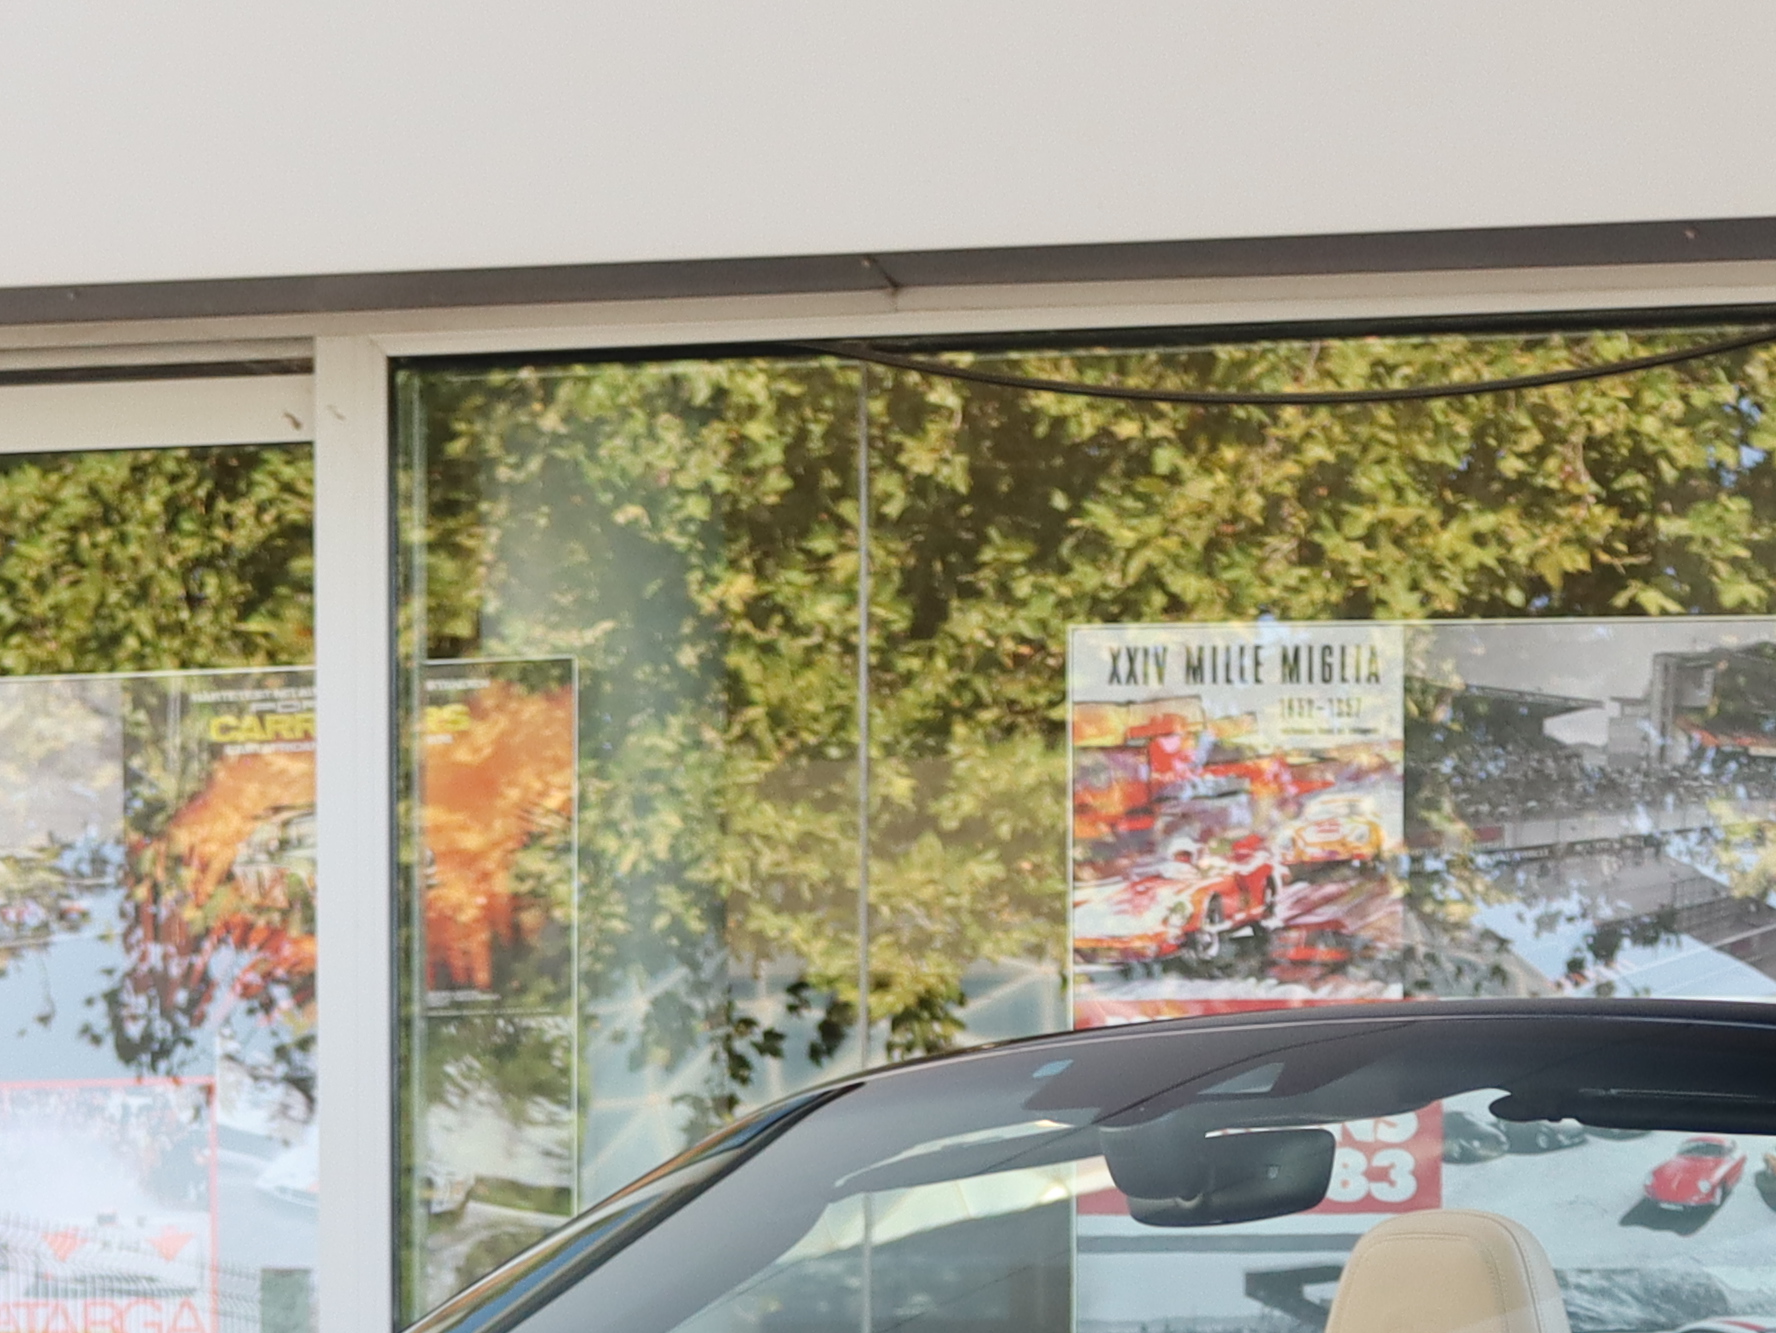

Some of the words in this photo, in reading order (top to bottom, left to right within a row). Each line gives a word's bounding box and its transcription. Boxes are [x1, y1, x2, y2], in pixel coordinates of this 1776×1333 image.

[1108, 645, 1167, 686] XXIV
[1185, 643, 1264, 685] MILLE
[1280, 643, 1381, 684] MIGLIA
[210, 712, 316, 741] CARR
